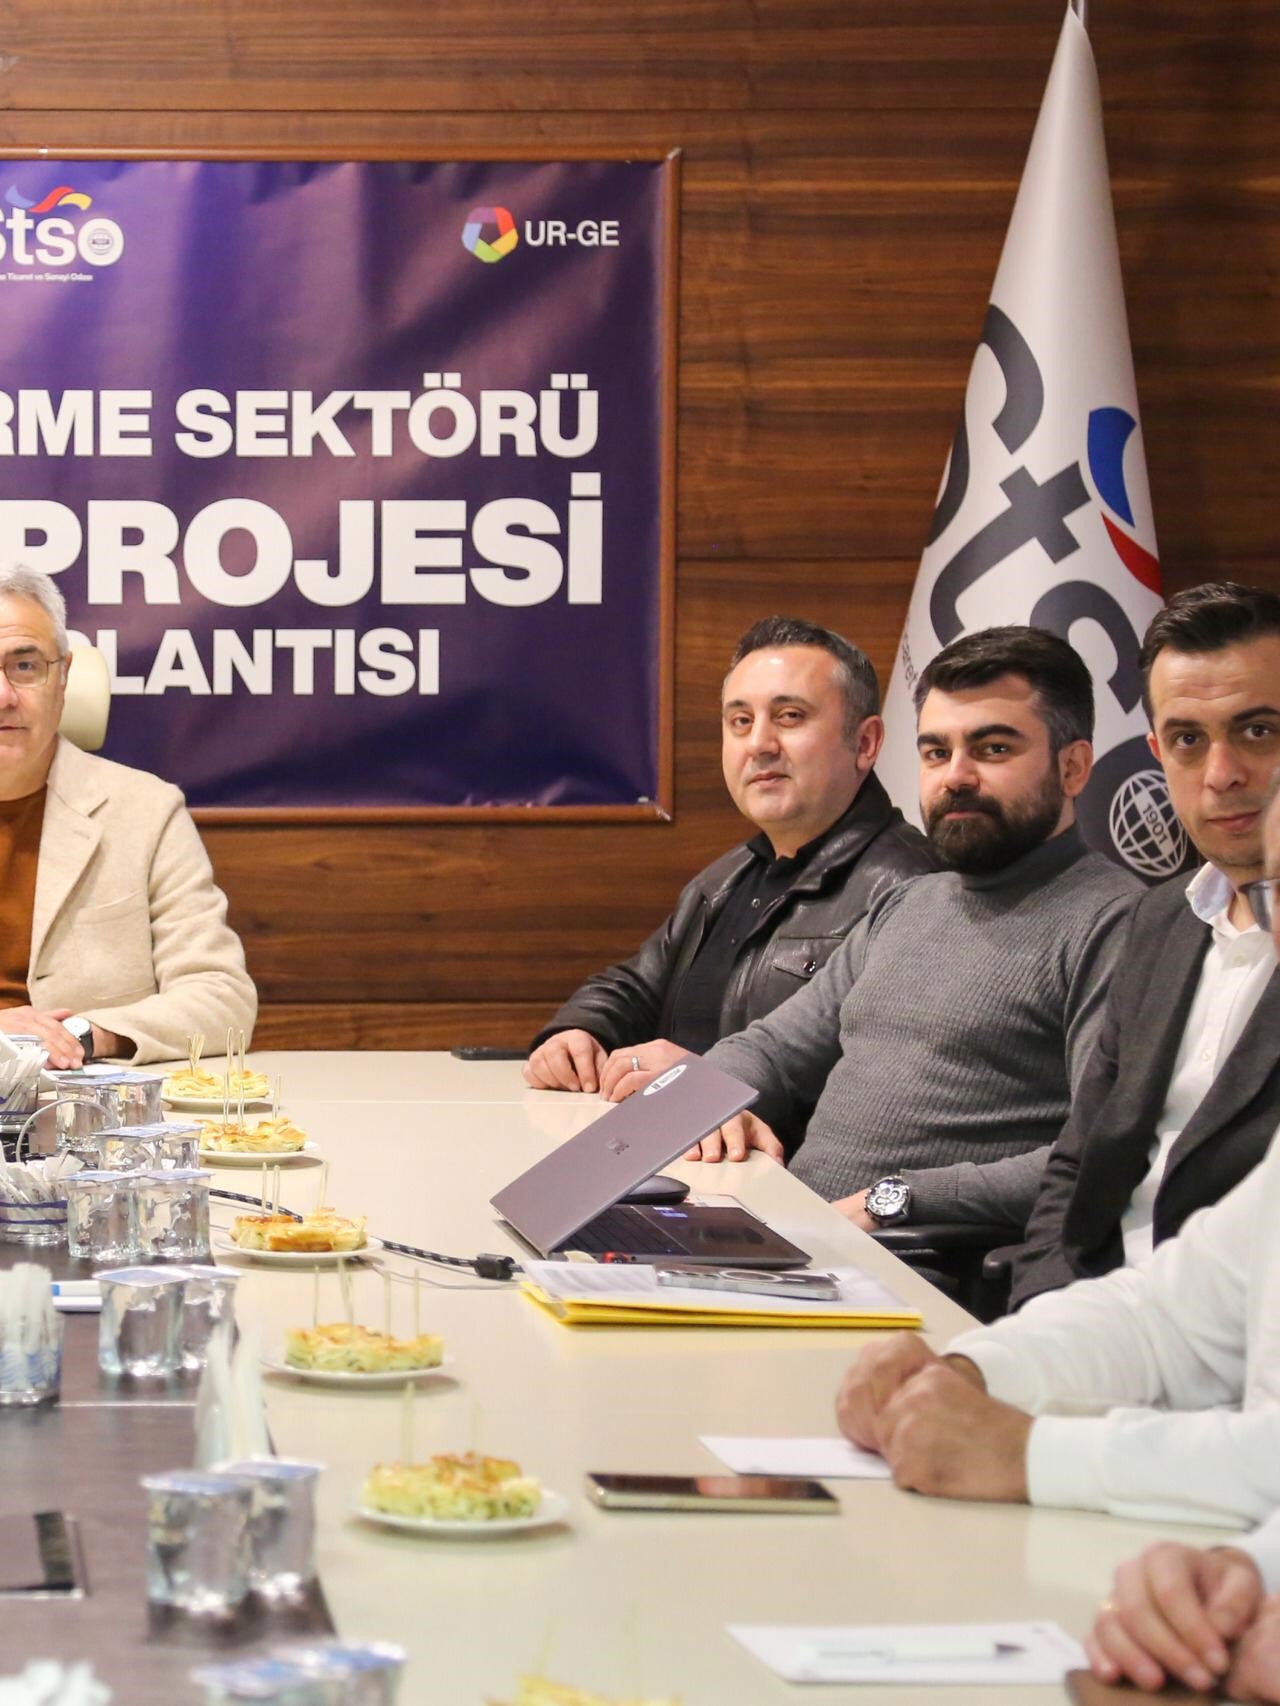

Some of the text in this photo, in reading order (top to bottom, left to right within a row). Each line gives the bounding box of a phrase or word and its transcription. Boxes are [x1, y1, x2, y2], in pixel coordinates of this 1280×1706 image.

[524, 220, 619, 246] UR-GE
[175, 372, 599, 458] SEKTÖRÜ
[1142, 802, 1168, 845] 1901
